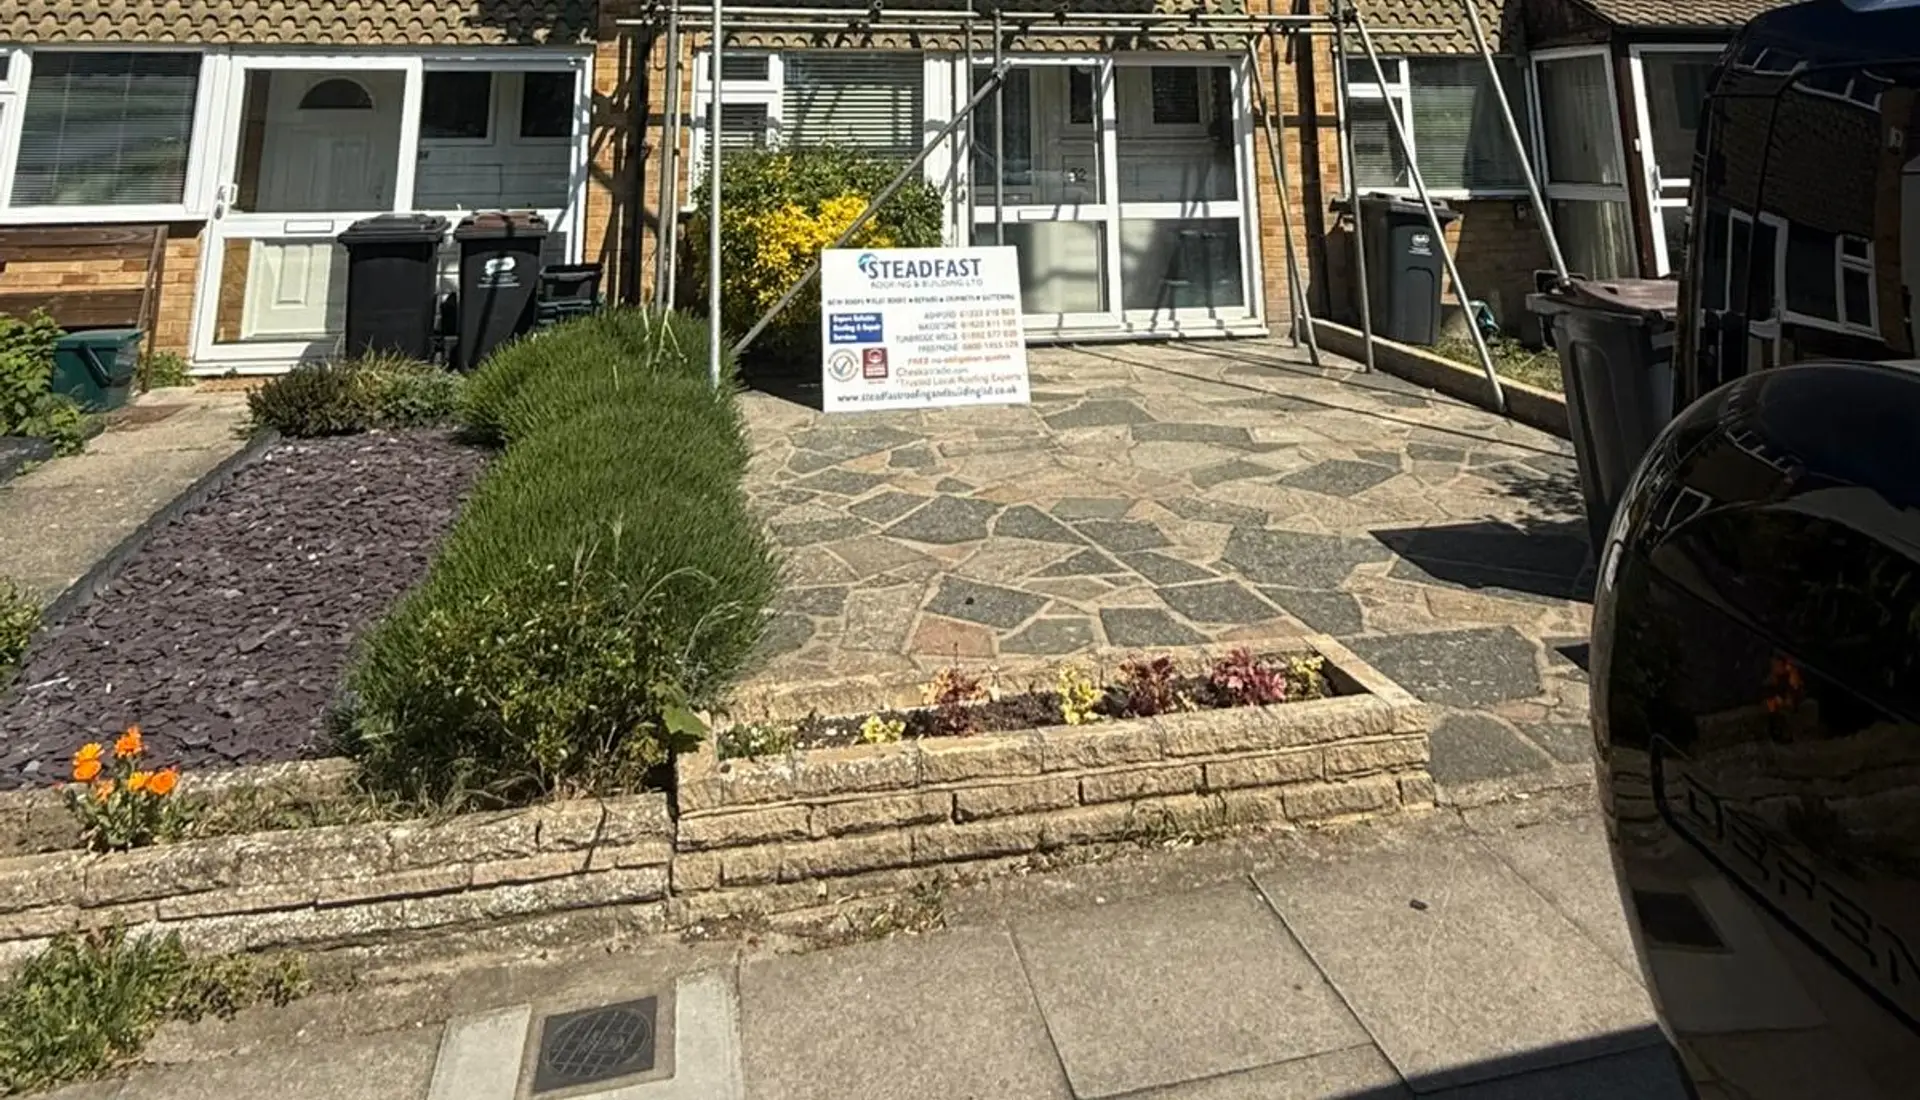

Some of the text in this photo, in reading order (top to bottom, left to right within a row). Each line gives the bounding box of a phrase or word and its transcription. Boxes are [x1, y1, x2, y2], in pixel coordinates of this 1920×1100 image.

[869, 258, 981, 279] STEADFAST
[871, 280, 912, 289] ROOFING
[922, 279, 964, 288] BUILDING
